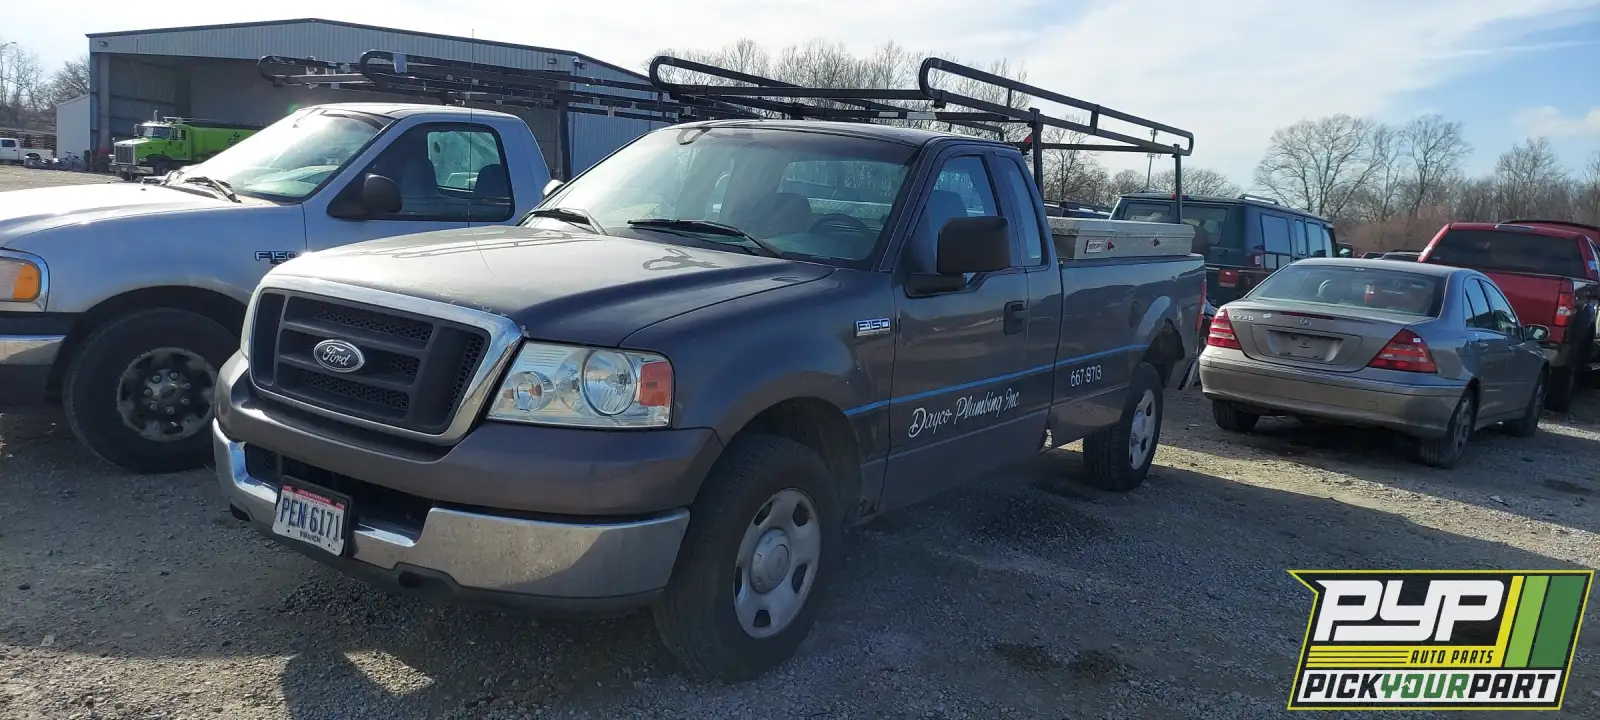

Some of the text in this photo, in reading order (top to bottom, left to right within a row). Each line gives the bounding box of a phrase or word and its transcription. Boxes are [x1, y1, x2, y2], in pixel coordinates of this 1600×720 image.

[322, 345, 351, 366] Ford
[908, 407, 953, 438] Dayco
[954, 391, 1003, 425] Plumbing
[280, 497, 308, 529] PEN
[309, 506, 340, 542] 6171
[299, 531, 322, 543] TRUCK
